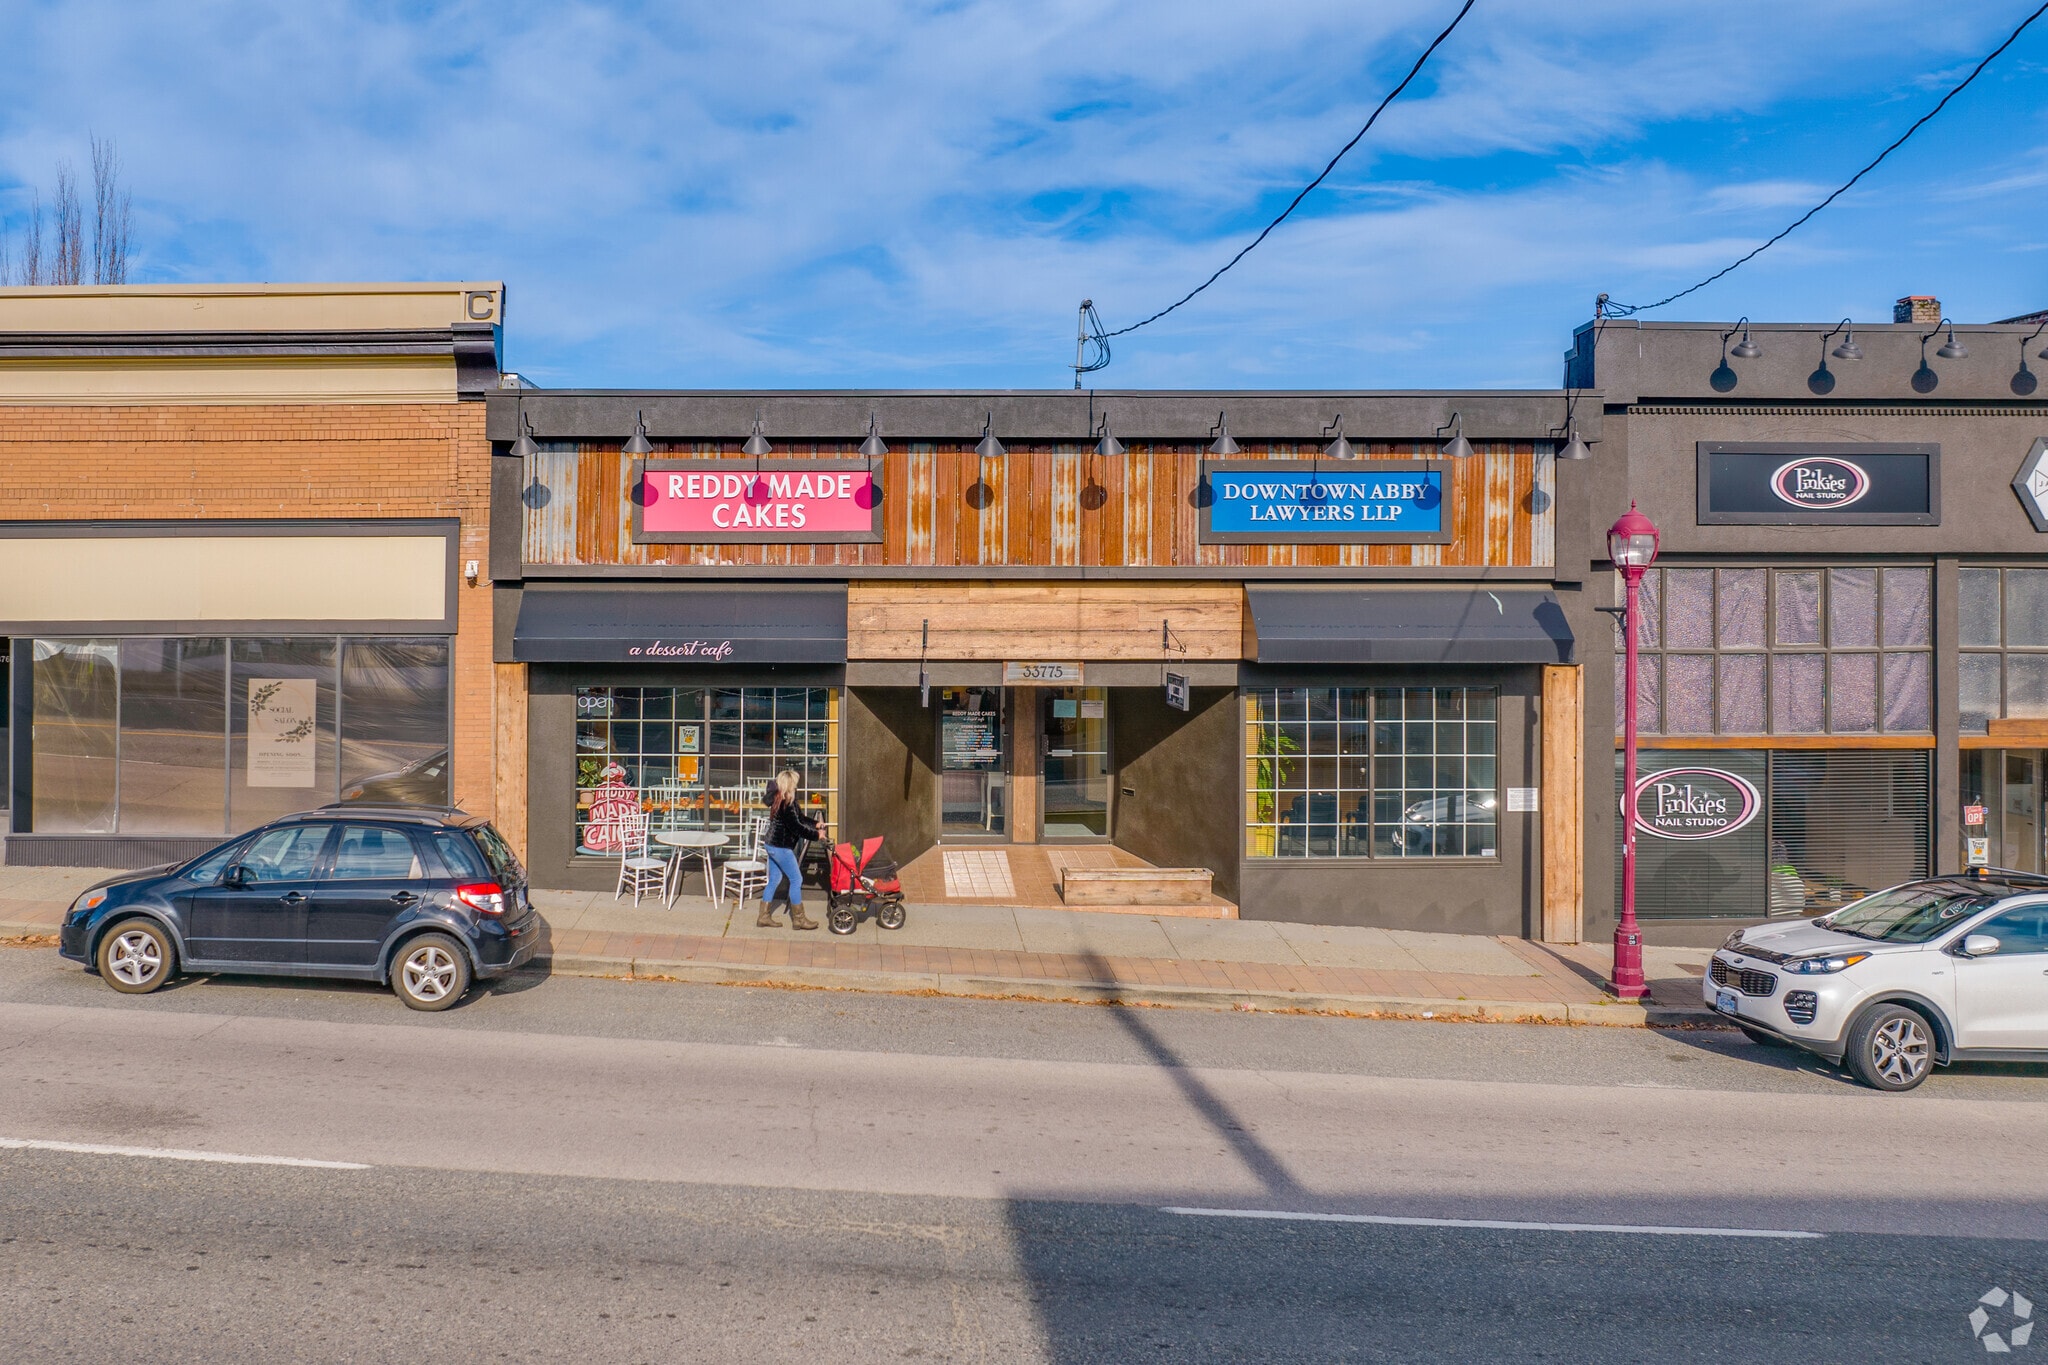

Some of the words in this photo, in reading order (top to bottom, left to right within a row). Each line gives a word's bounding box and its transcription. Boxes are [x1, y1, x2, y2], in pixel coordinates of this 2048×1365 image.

[668, 474, 760, 499] REDDY
[767, 474, 851, 499] MADE
[1794, 467, 1846, 492] Pinkies
[1223, 483, 1366, 500] DOWNTOWN
[1369, 483, 1429, 500] ABBY
[712, 503, 807, 529] CAKES
[1250, 505, 1355, 521] LAWYERS
[1361, 505, 1403, 521] LLP
[629, 647, 642, 655] a
[646, 640, 707, 656] dessert
[700, 641, 734, 661] cafe
[1023, 665, 1063, 678] 33775
[269, 705, 294, 714] SOCIAL
[578, 696, 614, 715] open
[1654, 783, 1727, 818] Pinkies
[1655, 818, 1683, 826] NAIL
[1685, 818, 1728, 826] STUDIO
[1967, 812, 1983, 823] OPE
[586, 824, 642, 844] CAK
